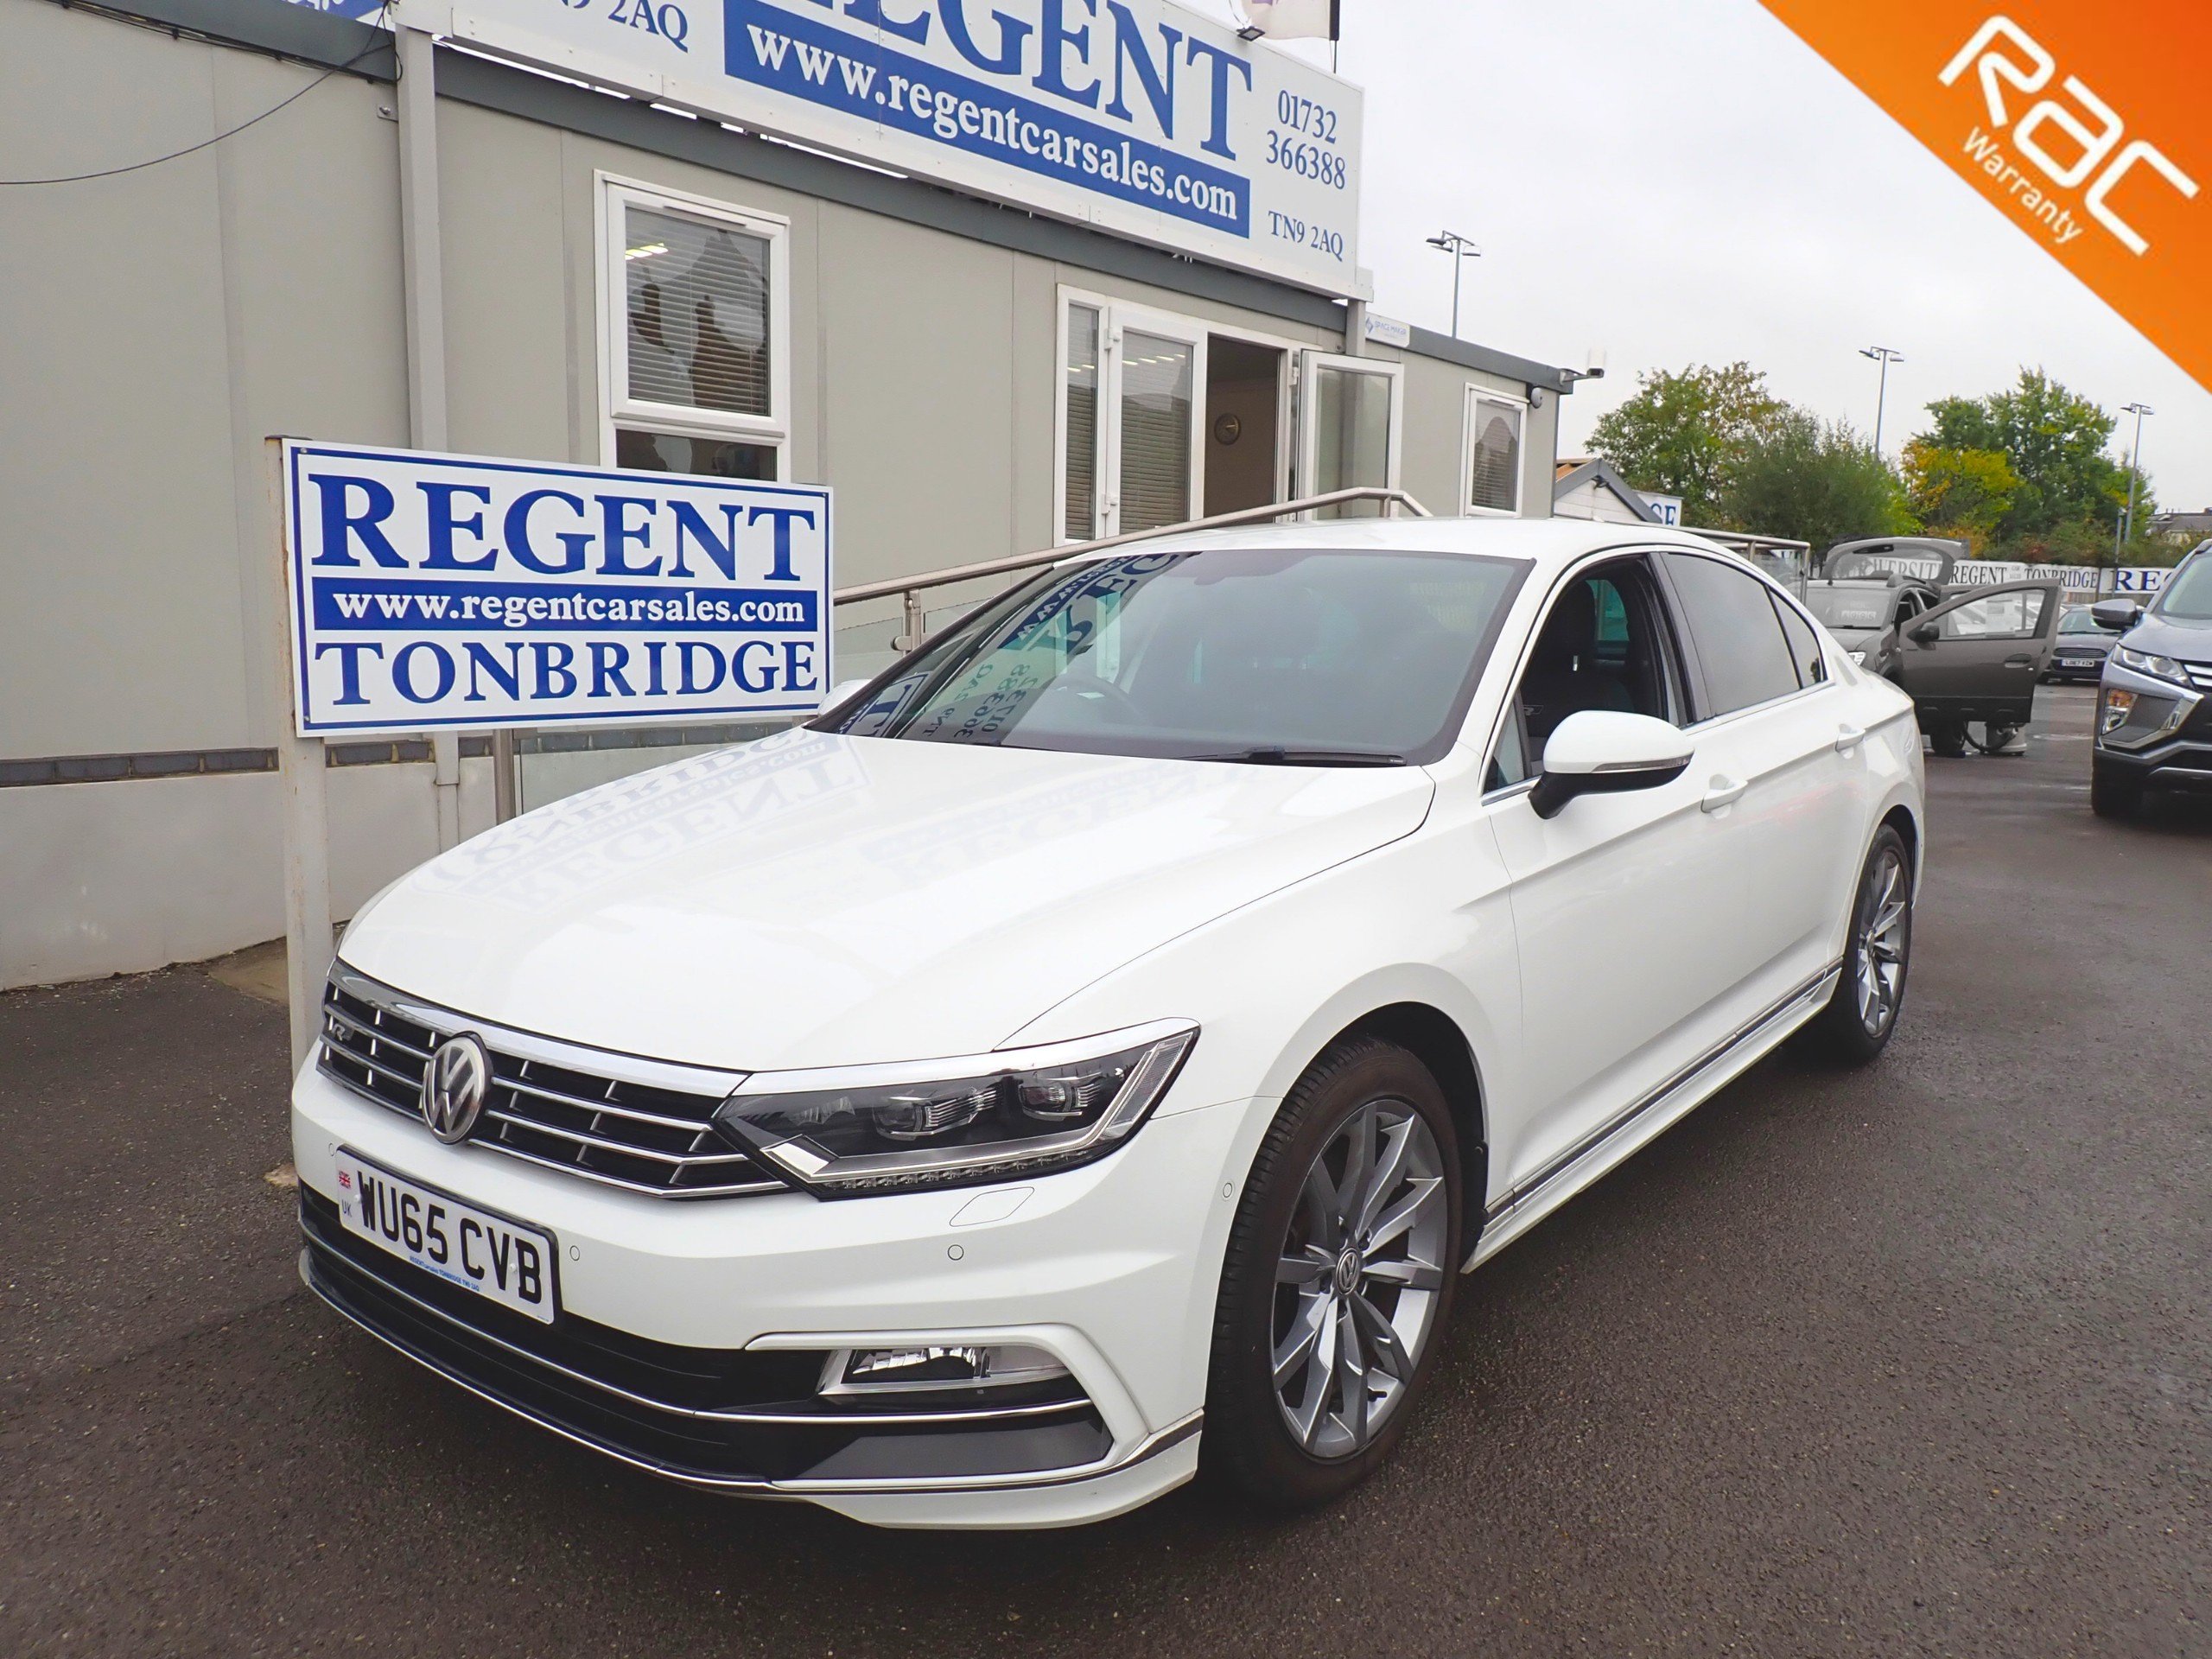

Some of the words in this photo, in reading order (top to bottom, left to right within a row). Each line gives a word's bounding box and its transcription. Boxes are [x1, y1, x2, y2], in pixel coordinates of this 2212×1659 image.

[747, 24, 1237, 220] www.regentcarsales.com
[1278, 90, 1337, 144] 01732
[1266, 130, 1345, 189] 366388
[1268, 211, 1305, 243] TN9
[1311, 226, 1343, 262] 2AQ
[308, 474, 815, 582] REGENT
[1950, 565, 2007, 585] REGENT
[334, 592, 805, 626] www.regentcarsales.com
[315, 639, 817, 705] TONBRIDGE
[357, 1170, 448, 1265] WU65
[460, 1217, 542, 1305] CVB
